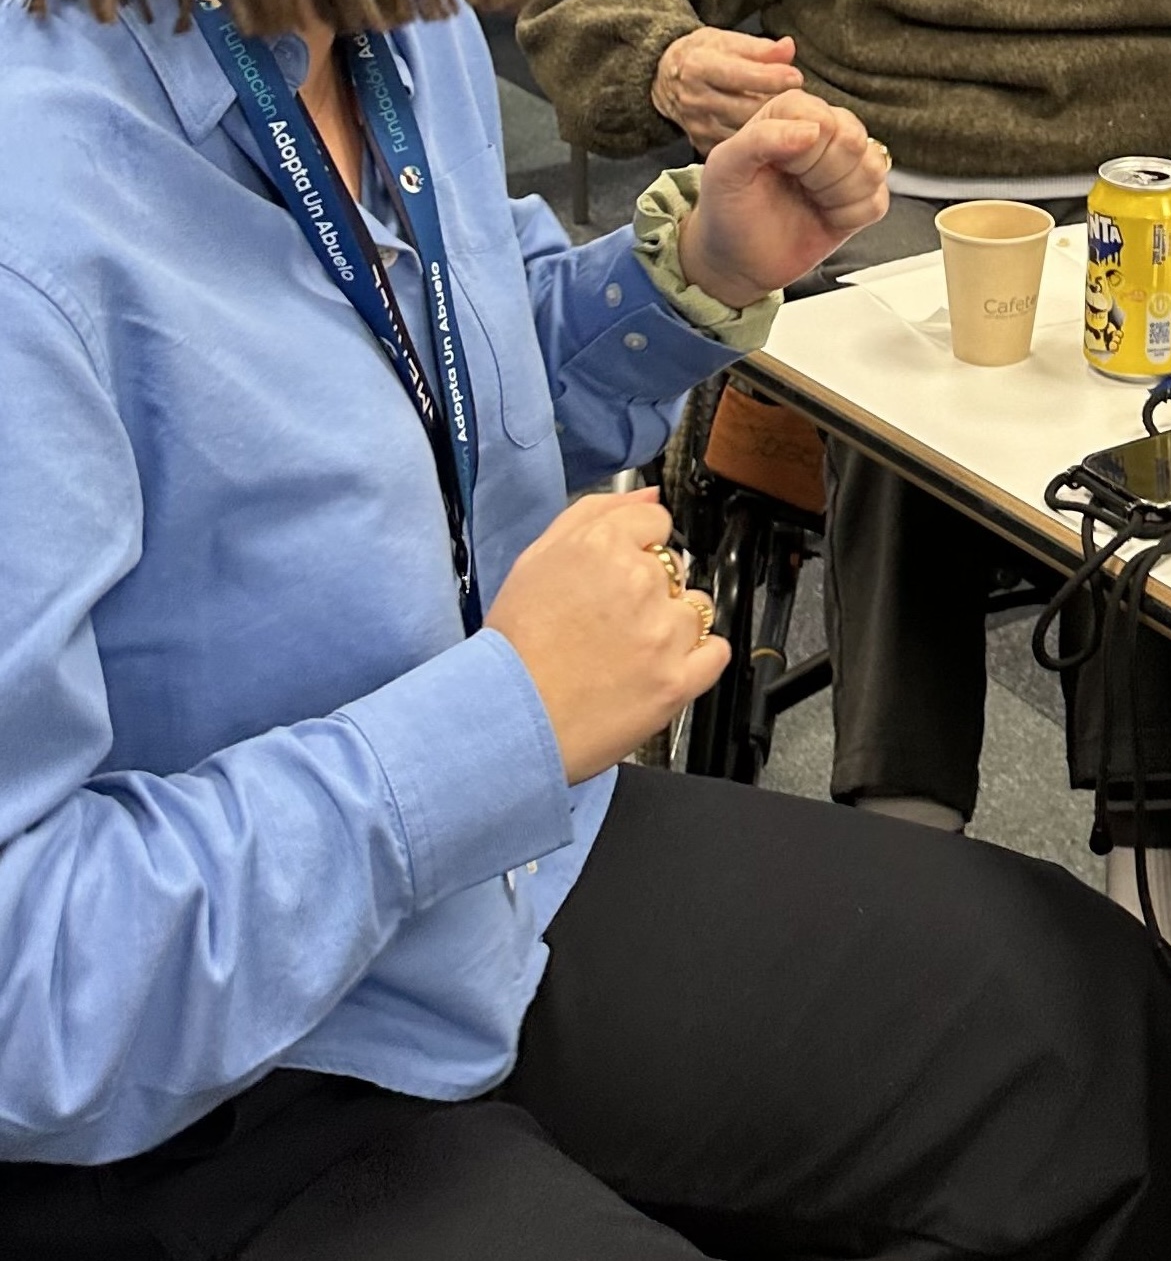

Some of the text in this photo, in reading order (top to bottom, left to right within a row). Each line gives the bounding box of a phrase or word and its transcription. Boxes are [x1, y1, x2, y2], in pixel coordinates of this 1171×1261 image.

[365, 60, 409, 154] Fundación
[218, 22, 355, 282] Fundación Adopta Un Abuelo
[431, 261, 450, 332] Abuelo
[443, 336, 455, 365] Un
[449, 367, 468, 442] Adopta
